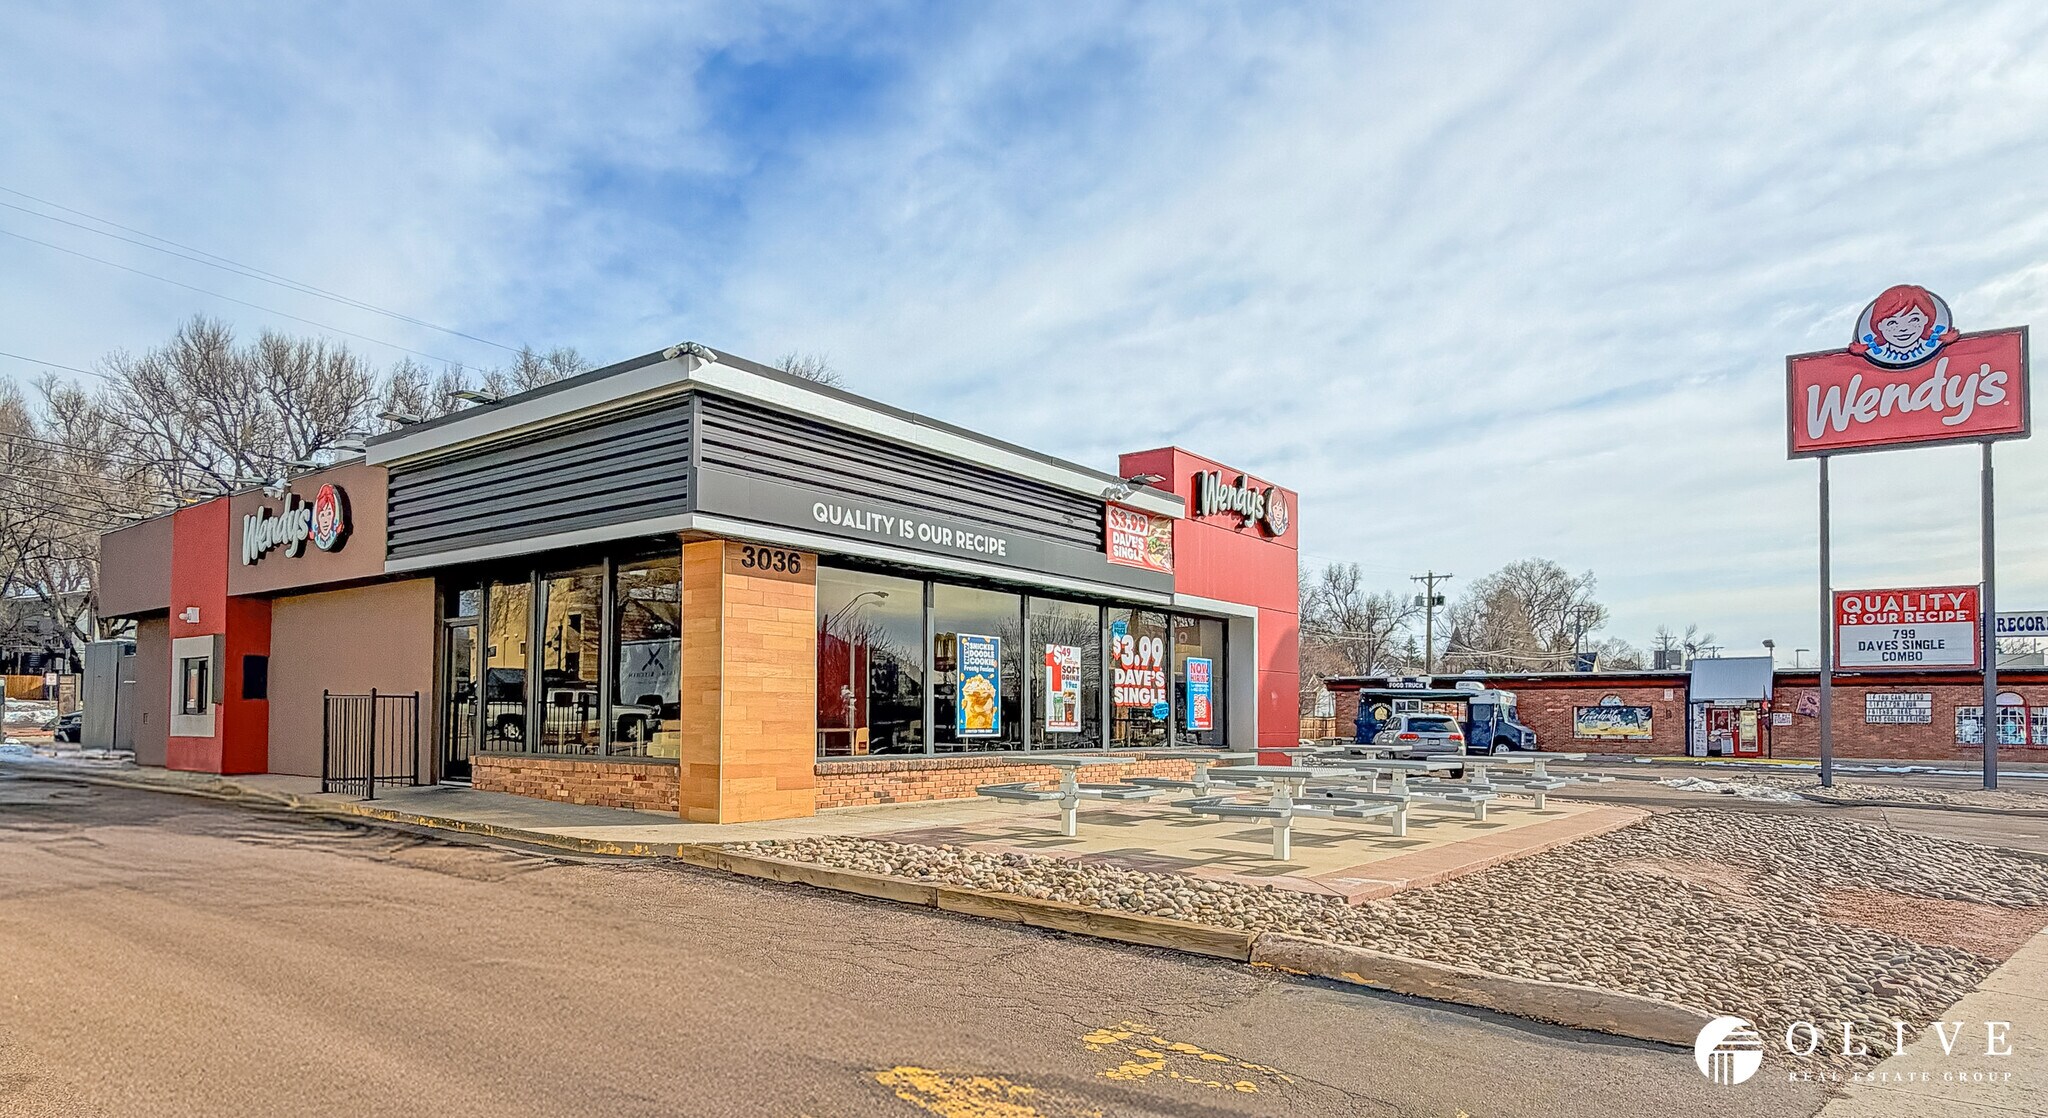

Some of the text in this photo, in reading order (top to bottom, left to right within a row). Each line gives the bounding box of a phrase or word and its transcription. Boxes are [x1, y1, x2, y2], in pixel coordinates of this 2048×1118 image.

[1807, 357, 2008, 439] Wendy's
[1201, 469, 1264, 527] Wendy's
[242, 492, 311, 566] Wendy's
[812, 502, 1007, 557] QUALITY IS OUR RECIPE
[1109, 507, 1147, 535] $3.99
[1112, 531, 1145, 549] DAVE'S
[741, 546, 801, 574] 3036
[1113, 545, 1144, 562] SINGLE
[1842, 592, 1967, 614] QUALITY
[1842, 610, 1967, 625] IS OUR RECIPE
[1996, 616, 2048, 632] RECOR
[1892, 629, 1916, 639] 799
[969, 649, 995, 658] DOODLE
[1112, 634, 1164, 668] $3.99
[1858, 639, 1945, 651] DAVES SINGLE
[969, 657, 995, 666] COOKIE
[1881, 651, 1923, 662] COMBO
[1061, 665, 1080, 675] SOFT
[1190, 662, 1209, 674] NOW
[1061, 674, 1080, 682] DRINK
[1114, 668, 1165, 687] DAVE'S
[1388, 681, 1424, 689] FOOD TRUCK
[1114, 686, 1166, 704] SINGLE
